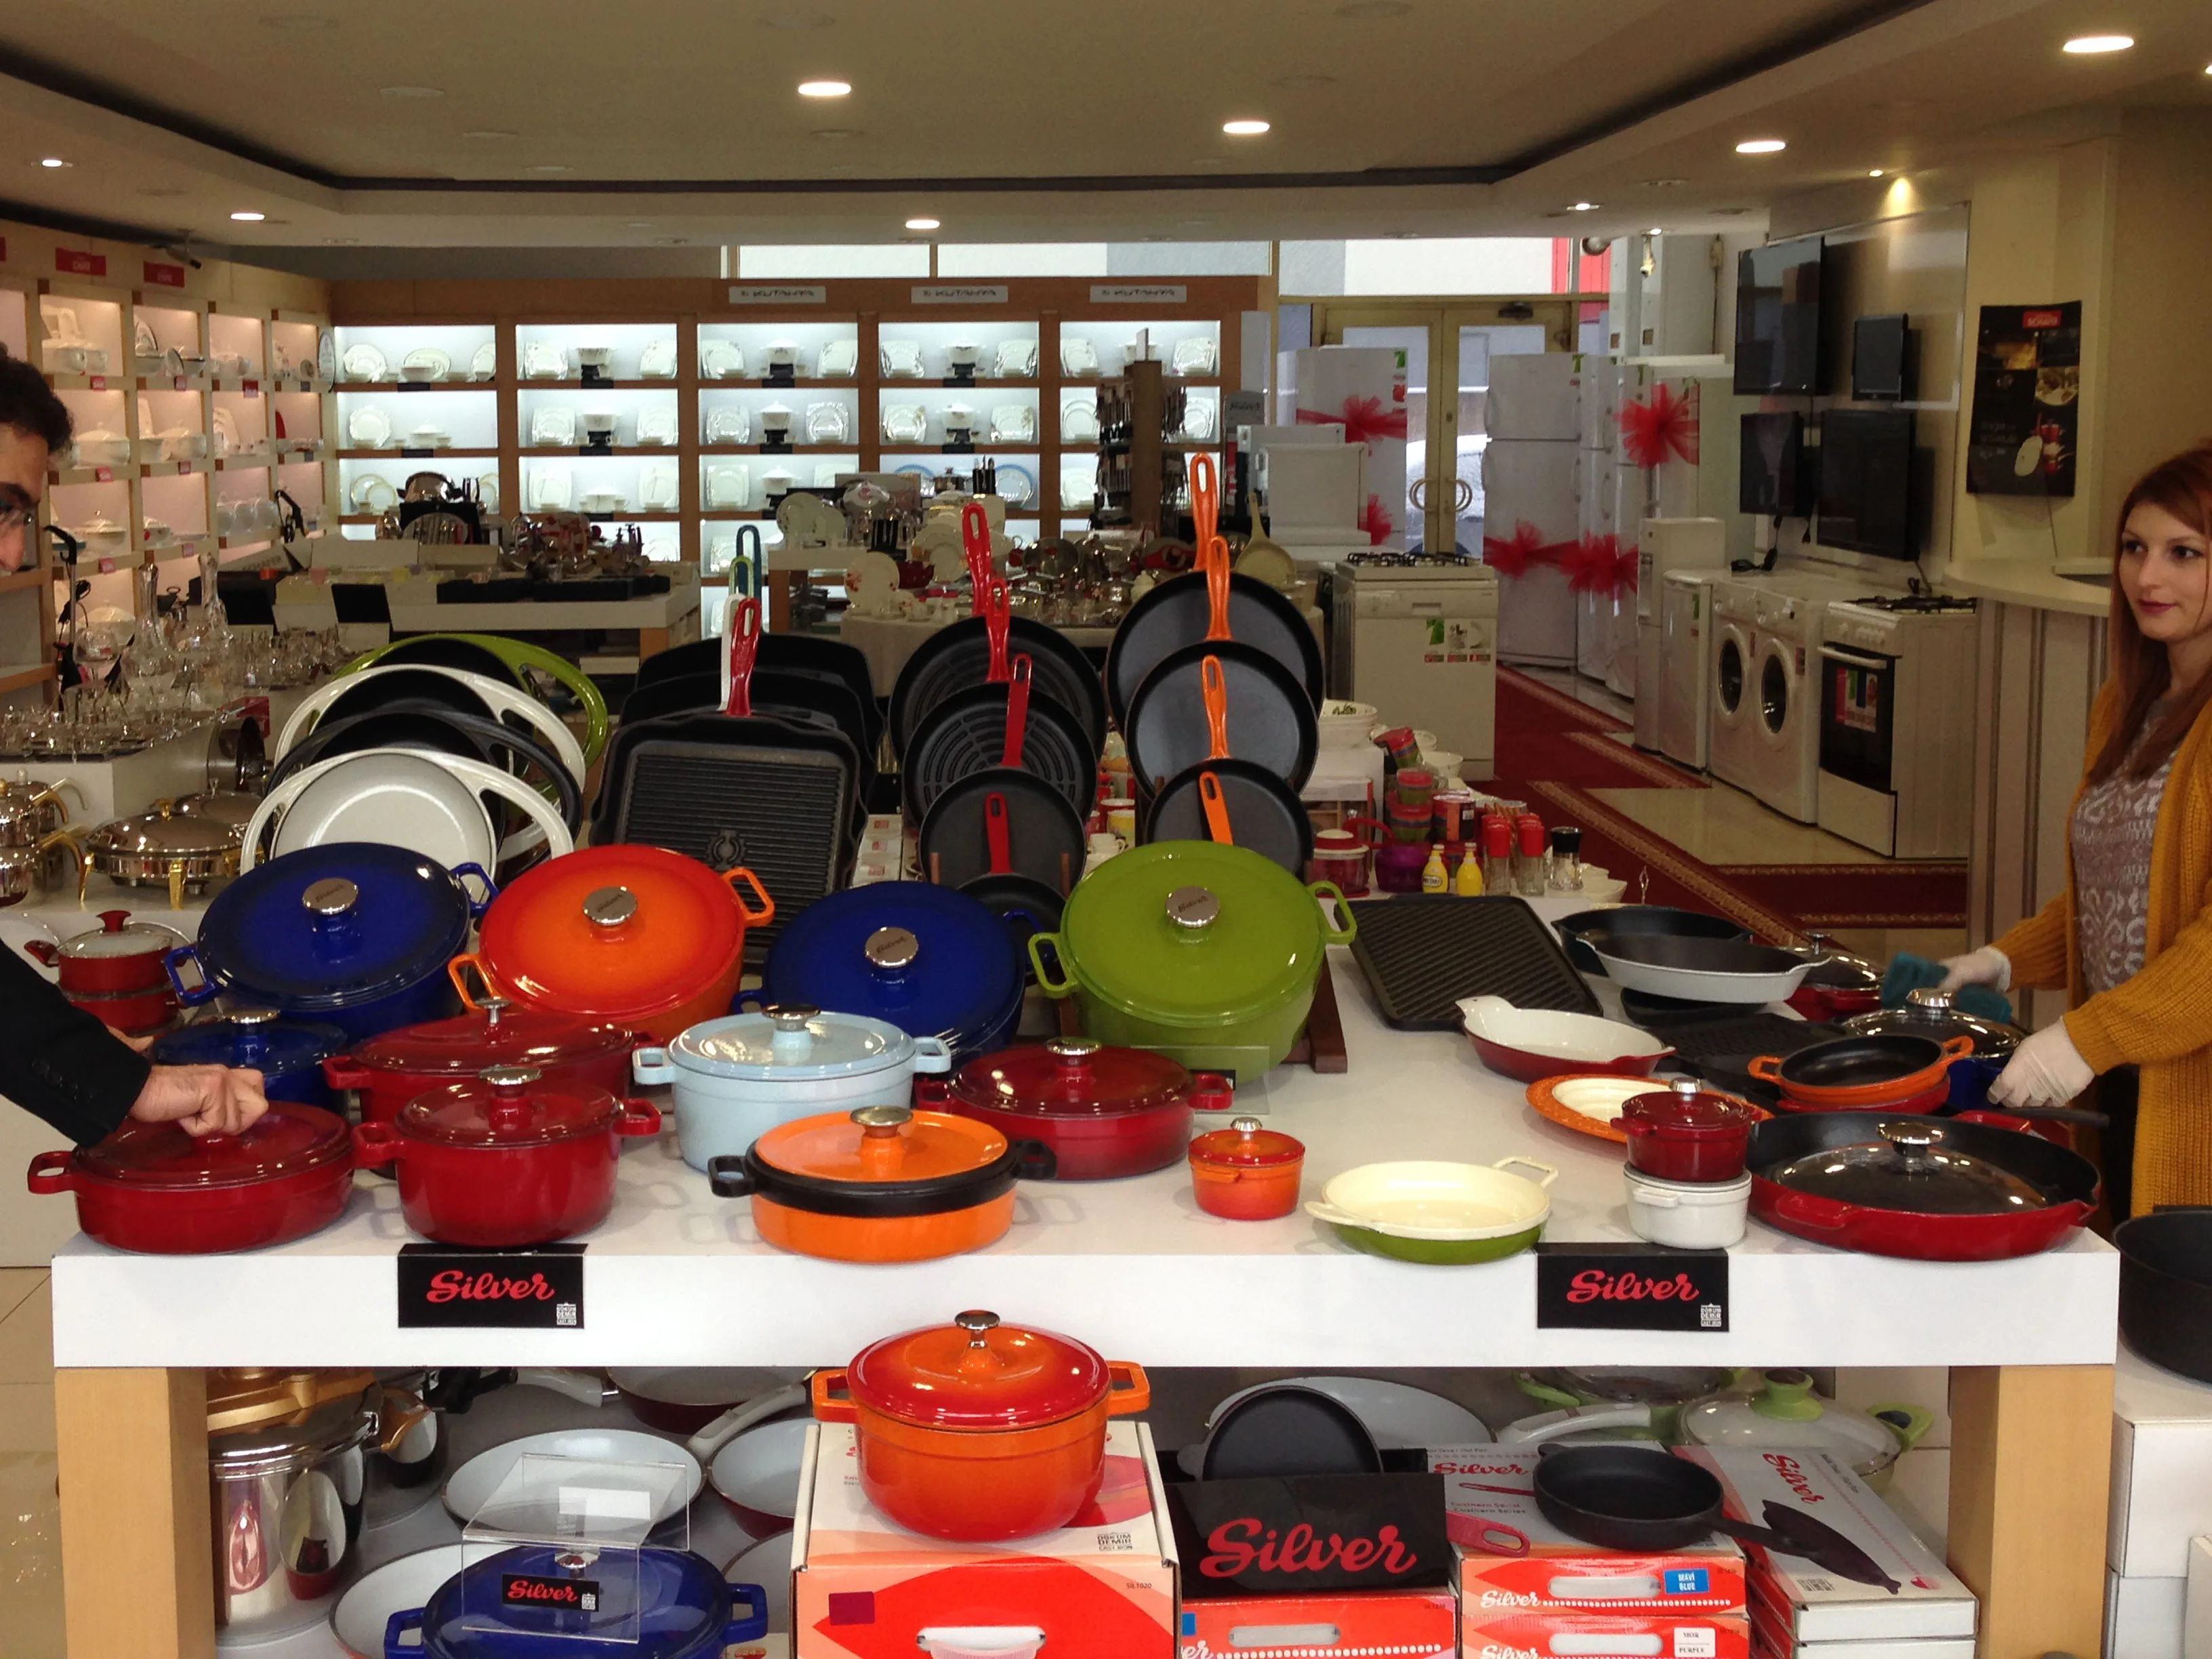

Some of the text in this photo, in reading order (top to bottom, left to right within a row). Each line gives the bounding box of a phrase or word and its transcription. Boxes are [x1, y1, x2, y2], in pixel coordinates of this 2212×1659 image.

[426, 1270, 555, 1303] Silver
[1566, 1269, 1700, 1303] Silver
[1433, 1462, 1529, 1475] Silver
[1763, 1454, 1824, 1504] Silver
[1200, 1518, 1418, 1578] Silver
[508, 1580, 577, 1602] Silver
[1679, 1582, 1696, 1591] BLUE
[1479, 1590, 1541, 1609] Silver
[1479, 1645, 1540, 1659] Silver
